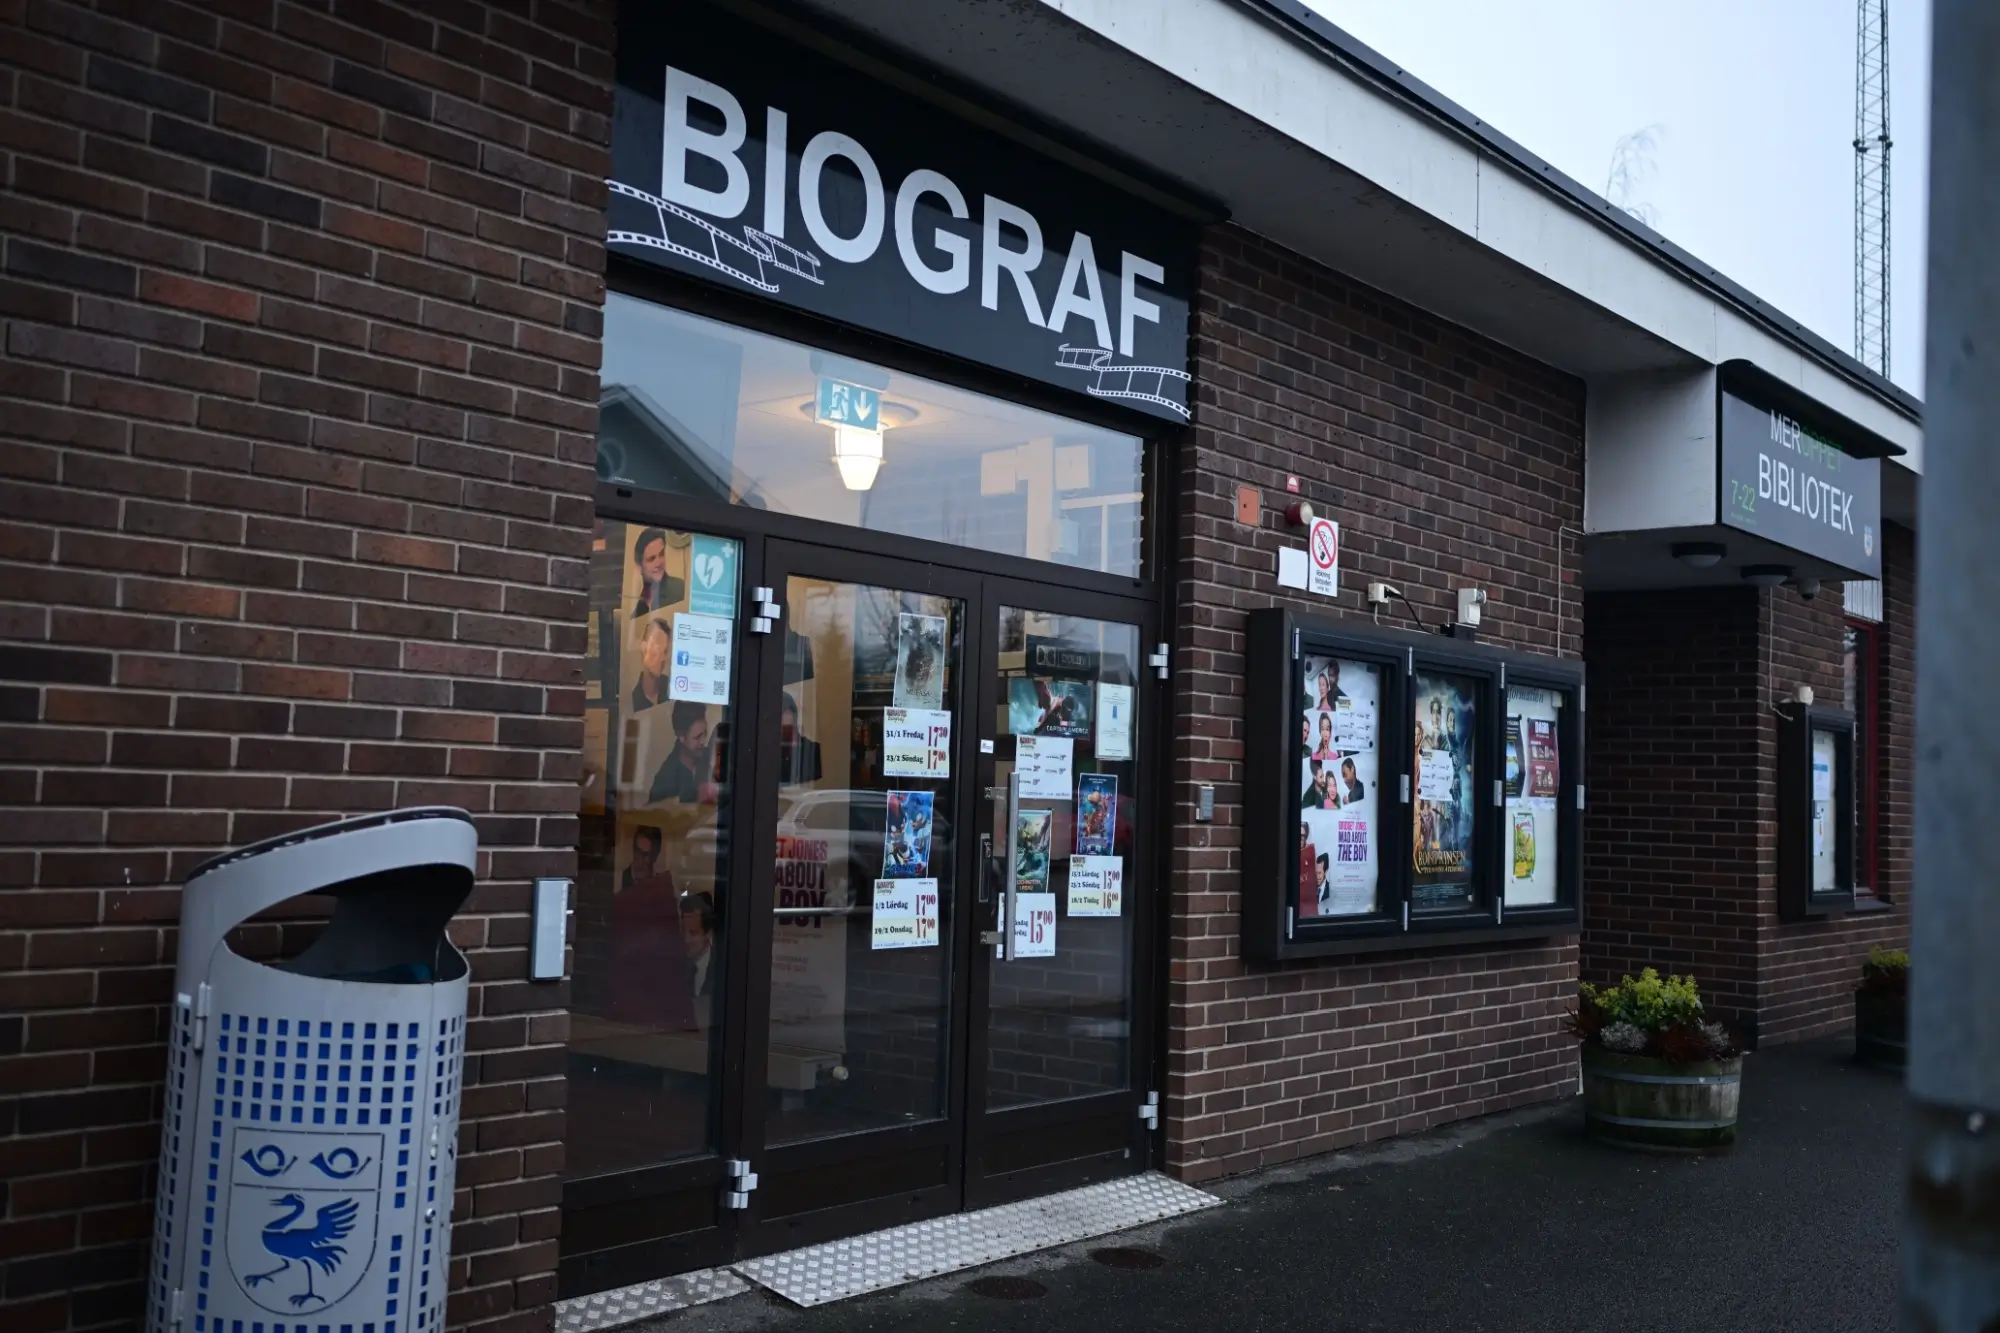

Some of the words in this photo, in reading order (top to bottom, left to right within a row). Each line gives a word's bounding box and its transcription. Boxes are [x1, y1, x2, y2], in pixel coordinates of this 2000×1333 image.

[661, 65, 1164, 357] BIOGRAF
[1731, 479, 1756, 513] 7-22
[1759, 452, 1854, 535] BIBLIOTEK
[1507, 686, 1544, 703] formation
[886, 730, 901, 739] 31/1
[902, 730, 924, 740] Fredag
[901, 754, 924, 764] Söndag
[1338, 831, 1351, 843] MAD
[1352, 832, 1368, 843] ABOUT
[788, 839, 828, 861] JONES
[1338, 844, 1352, 861] THE
[1353, 844, 1368, 861] BOY
[775, 862, 827, 889] ABOUT
[778, 889, 827, 928] BOY
[876, 901, 885, 911] 1/2
[886, 900, 908, 910] Lördag
[890, 926, 913, 934] Onsdag
